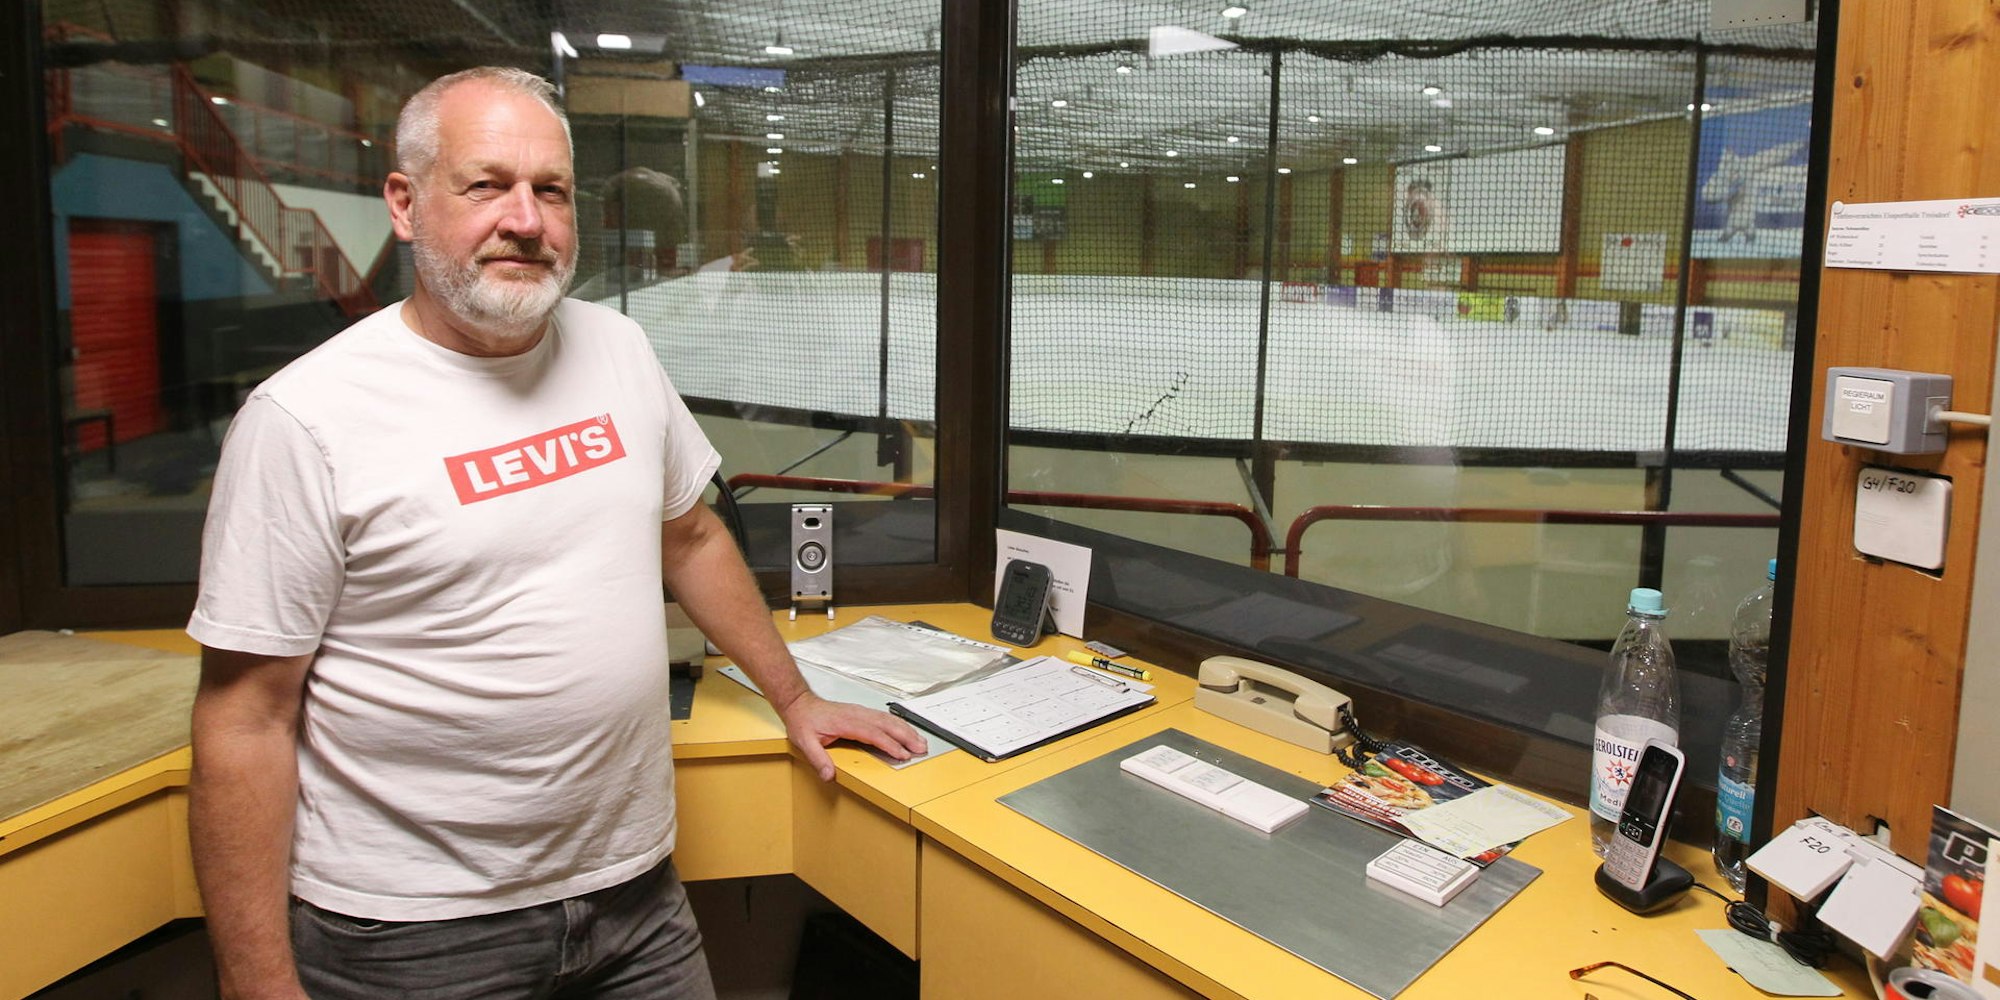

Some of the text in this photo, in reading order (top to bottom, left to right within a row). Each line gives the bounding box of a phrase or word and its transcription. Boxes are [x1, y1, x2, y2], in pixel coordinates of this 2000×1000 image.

[1843, 389, 1885, 400] REGIERAUM
[1850, 402, 1872, 411] LICHT
[463, 425, 612, 494] LEVI'S
[1799, 836, 1831, 854] F20
[1442, 855, 1459, 865] AUS
